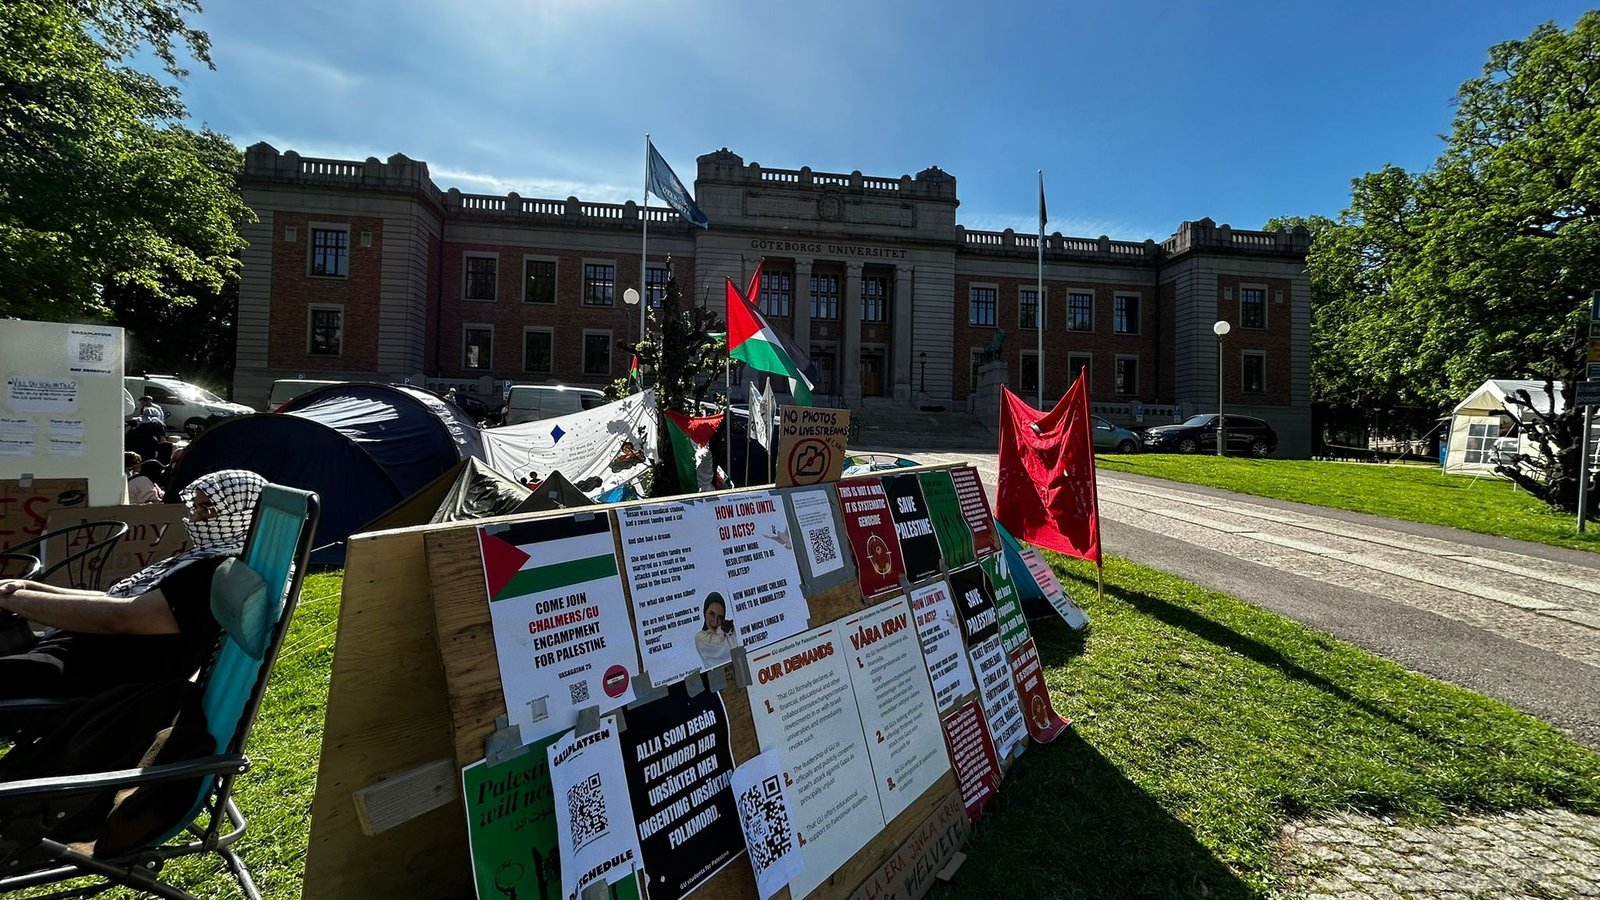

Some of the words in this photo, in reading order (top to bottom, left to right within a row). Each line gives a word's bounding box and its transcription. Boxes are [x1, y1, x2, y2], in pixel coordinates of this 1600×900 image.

[751, 240, 821, 252] GÖTEBORGS
[828, 245, 907, 258] UNIVERSITET
[784, 410, 797, 423] NO
[802, 411, 837, 425] PHOTOS
[784, 426, 797, 435] NO
[839, 487, 852, 497] THIS
[851, 487, 858, 496] IS
[856, 486, 867, 496] NOT
[866, 486, 871, 494] A
[715, 505, 734, 520] HOW
[736, 502, 755, 516] LONG
[756, 500, 776, 514] UNTIL
[845, 503, 851, 513] IT
[851, 502, 857, 512] IS
[857, 499, 885, 511] SYSTEMATIC
[897, 496, 916, 513] SAVE
[858, 514, 881, 527] GENOCIDE
[896, 518, 932, 539] PALESTINE
[720, 526, 730, 540] GU
[732, 522, 755, 538] ACTS?
[723, 547, 733, 555] HOW
[734, 544, 746, 552] MANY
[747, 542, 759, 550] MORE
[725, 554, 752, 566] RESOLUTIONS
[753, 552, 764, 560] HAVE
[728, 566, 750, 577] VIOLATED?
[733, 591, 743, 600] HOW
[744, 587, 756, 596] MANY
[757, 584, 768, 593] MORE
[769, 579, 787, 589] CHILDREN
[965, 590, 982, 608] SAVE
[536, 598, 564, 614] COME
[566, 592, 586, 607] JOIN
[736, 602, 747, 612] HAVE
[747, 600, 753, 608] TO
[753, 598, 759, 606] BE
[760, 590, 785, 604] ANNIHILATED?
[529, 606, 599, 634] CHALMERS/GU
[740, 625, 750, 634] HOW
[751, 620, 764, 630] MUCH
[764, 615, 779, 626] LONGER
[966, 608, 997, 636] PALESTINE
[534, 622, 600, 650] ENCAMPMENT
[743, 631, 768, 646] APARTHEID?
[850, 625, 882, 650] VÅRA
[881, 613, 907, 637] KRAV
[535, 652, 555, 668] FOR
[556, 637, 606, 662] PALESTINE
[558, 666, 584, 679] VASAGATAN
[758, 663, 783, 684] OUR
[783, 642, 834, 674] DEMANDS
[637, 736, 662, 762] ALLA
[664, 724, 686, 747] SOM
[687, 710, 716, 736] BEGÅR
[876, 730, 884, 744] 2.
[643, 744, 699, 783] FOLKMORD
[698, 733, 715, 754] HAR
[646, 767, 696, 806] URSÄKTER
[697, 754, 718, 778] MEN
[783, 772, 793, 787] 2.
[480, 795, 520, 827] will
[639, 797, 690, 840] INGENTING
[668, 805, 720, 849] FOLKMORD.
[578, 849, 633, 889] SCHEDULE
[884, 854, 906, 884] ERA
